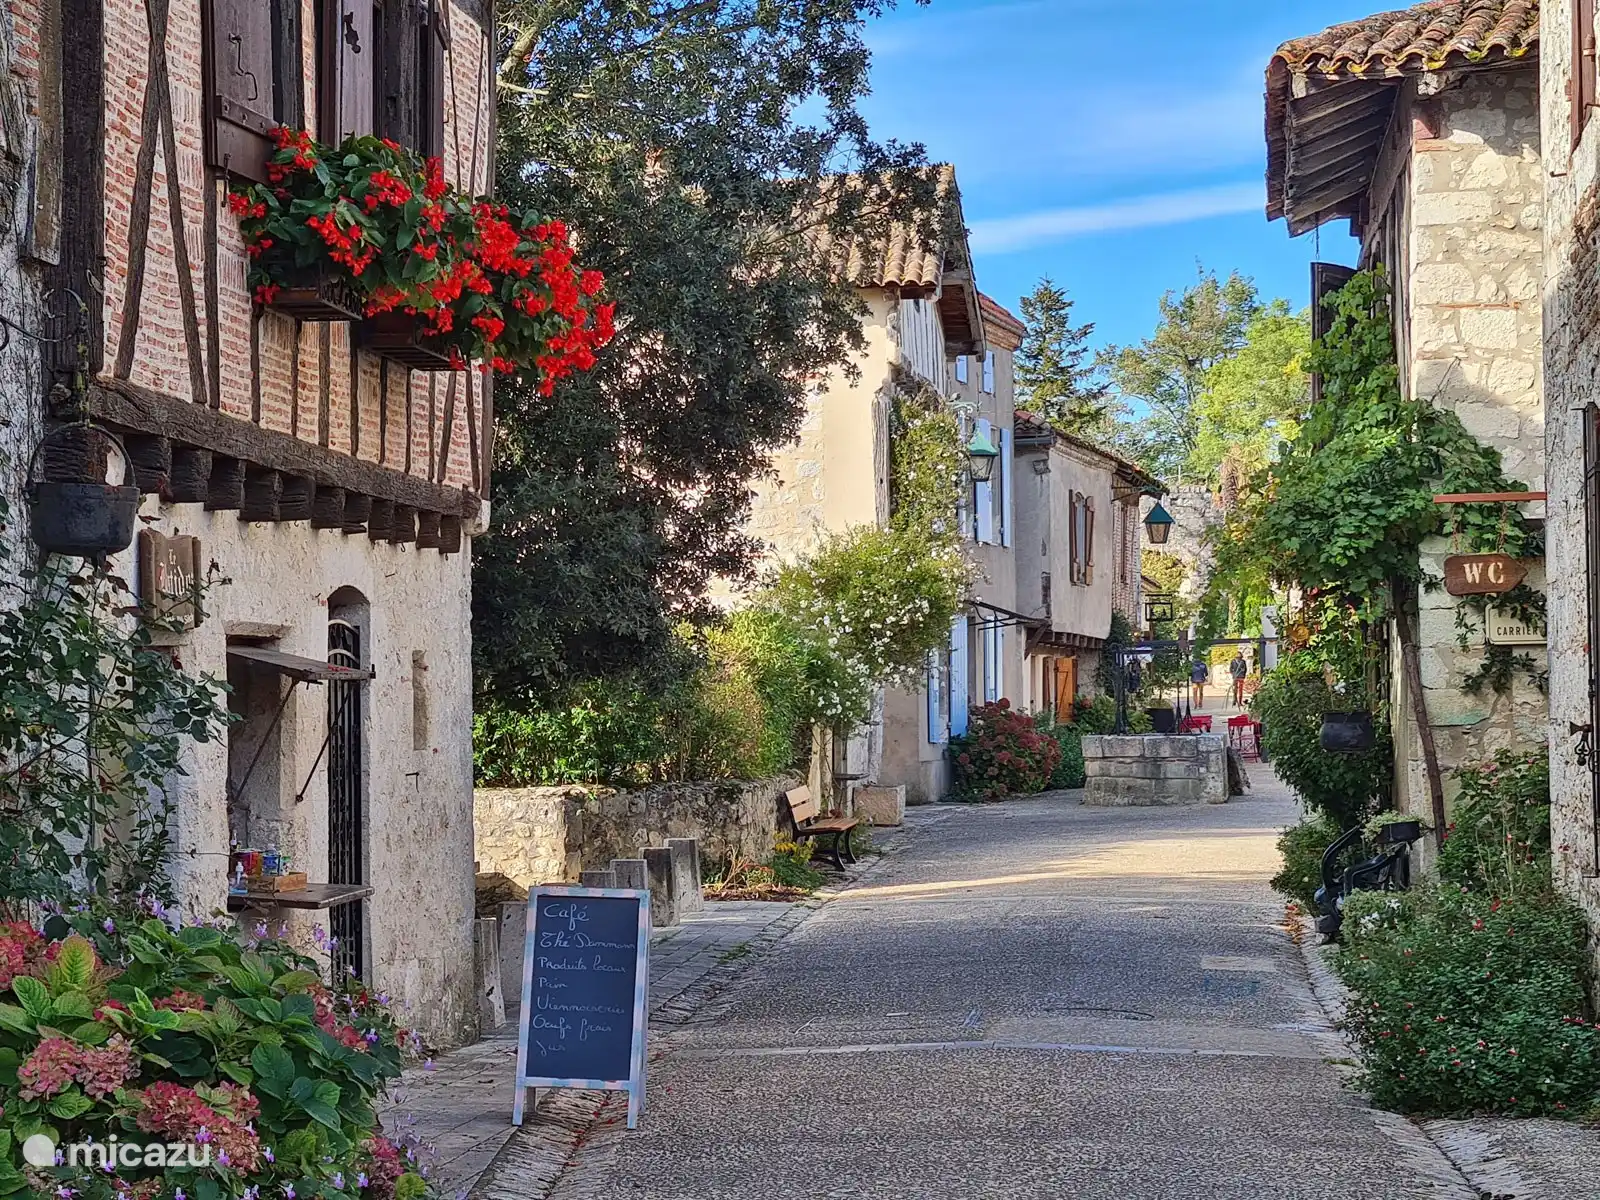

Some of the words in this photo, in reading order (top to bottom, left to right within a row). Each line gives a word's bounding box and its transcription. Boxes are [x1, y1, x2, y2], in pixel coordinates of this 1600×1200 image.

[1463, 562, 1504, 584] WC
[1496, 626, 1541, 636] CARRIER
[543, 903, 590, 931] Café
[539, 930, 571, 948] Thé
[537, 956, 587, 971] Produits
[538, 976, 568, 989] Pain
